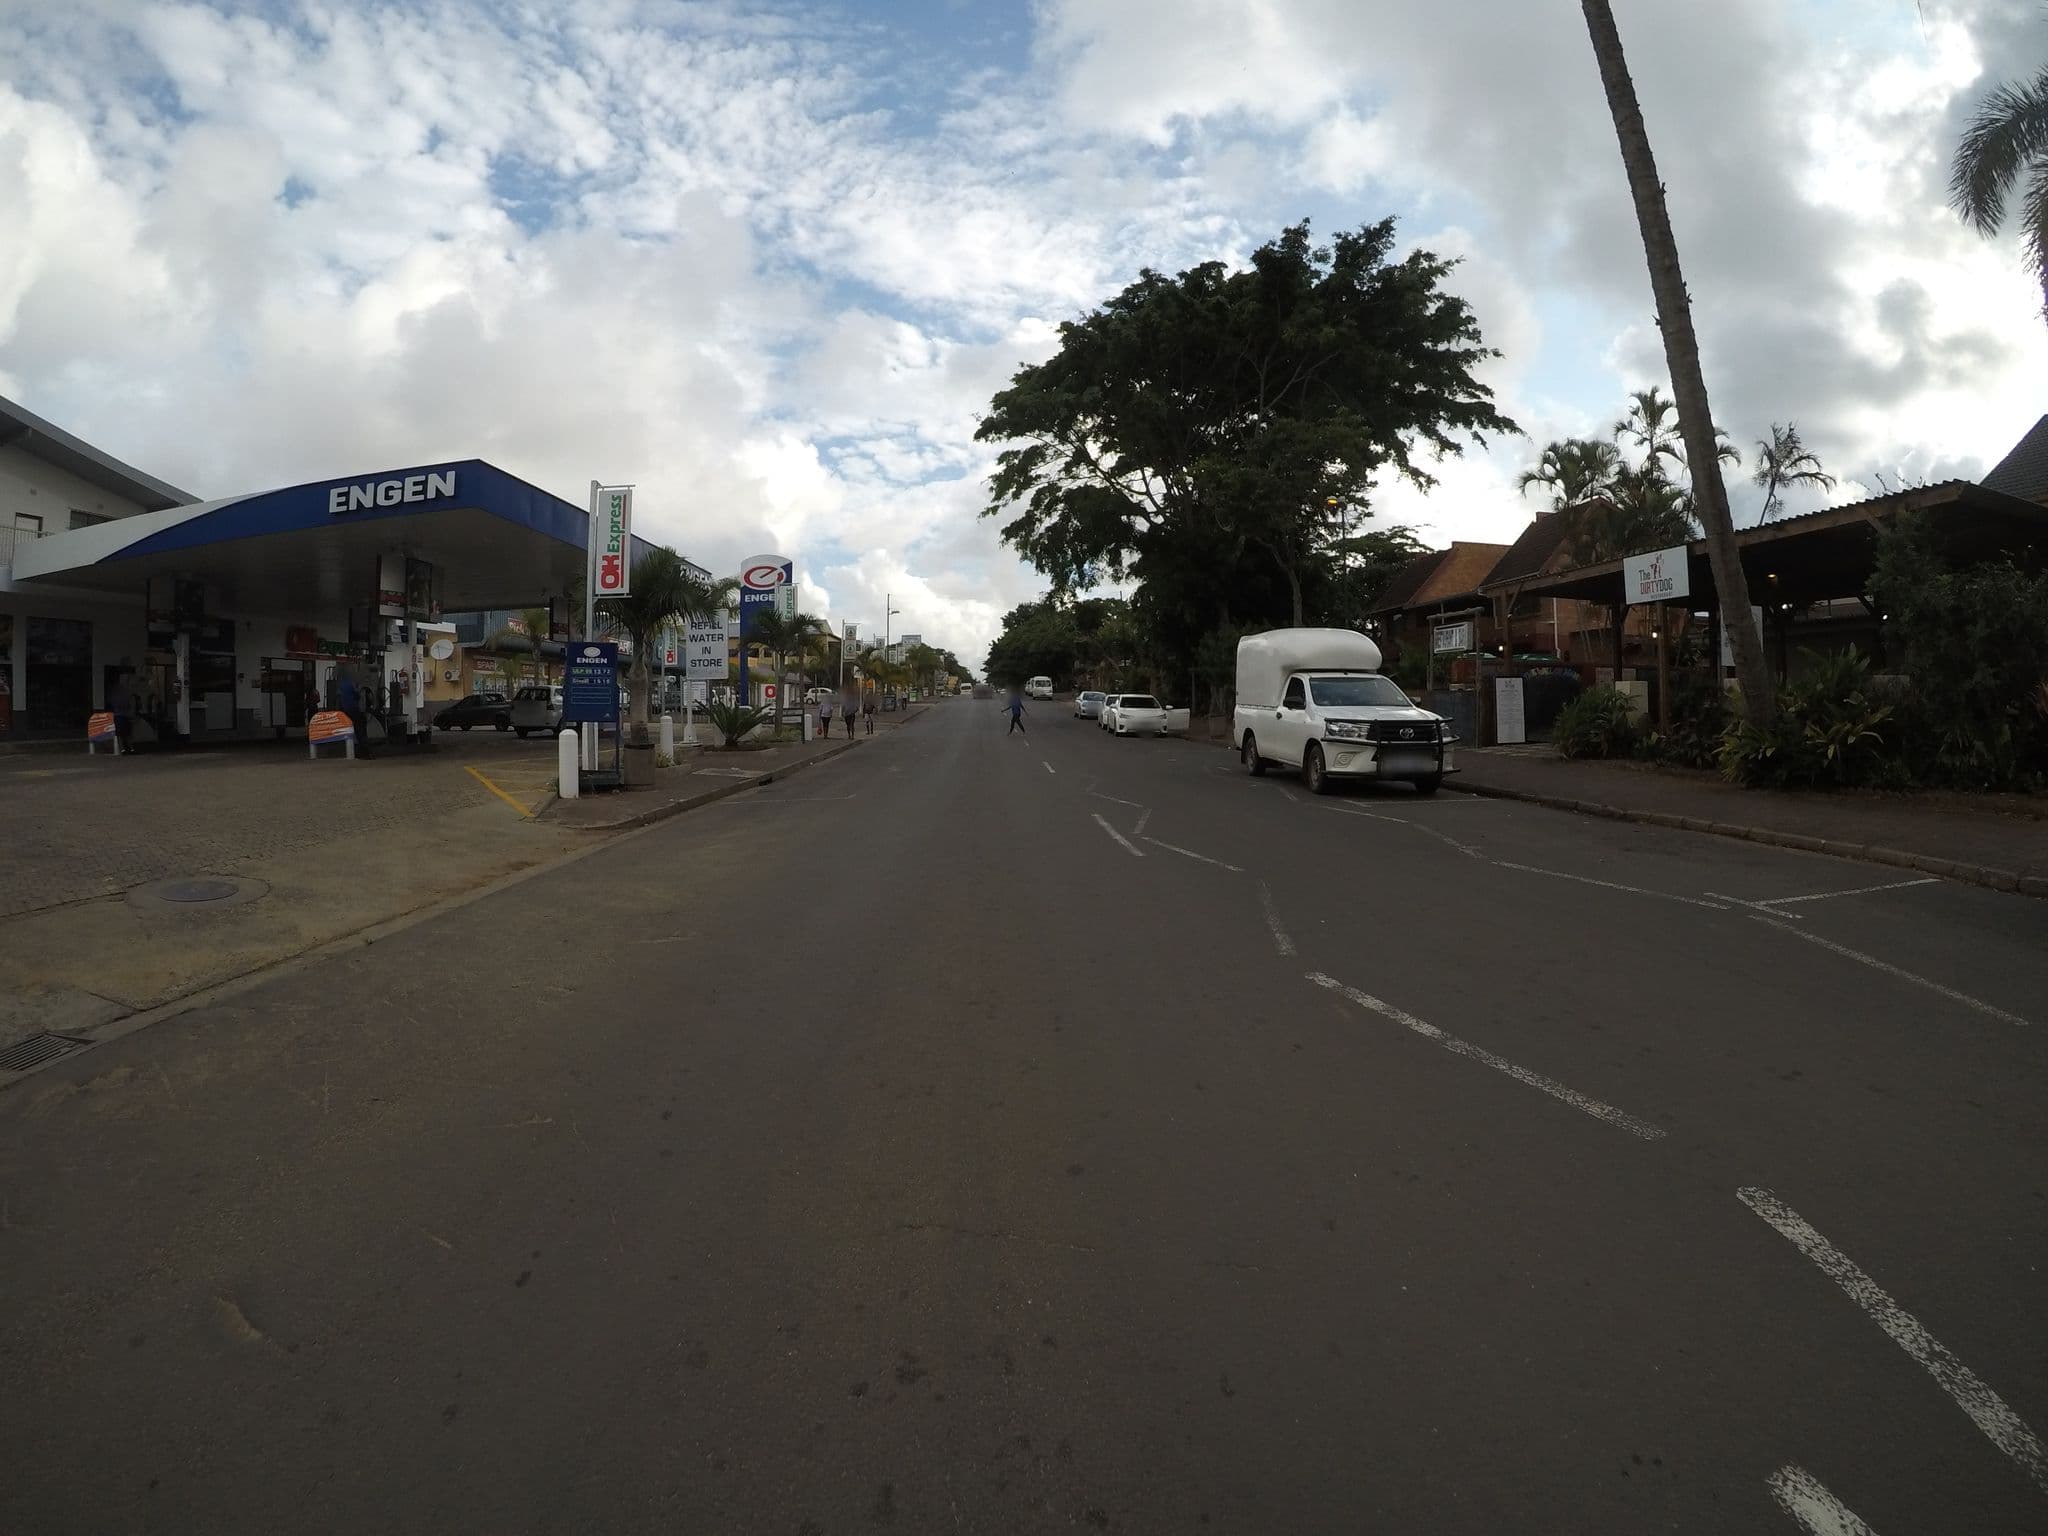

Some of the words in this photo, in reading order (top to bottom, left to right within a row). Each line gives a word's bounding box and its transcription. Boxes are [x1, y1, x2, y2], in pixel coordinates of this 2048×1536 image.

[329, 471, 456, 514] ENGEN
[607, 495, 625, 553] Express
[601, 555, 620, 589] OK
[1639, 569, 1651, 581] The
[745, 593, 777, 603] ENGE
[690, 621, 723, 630] REFILL
[688, 633, 724, 643] WATER
[701, 646, 712, 655] IN
[690, 658, 722, 668] STORE
